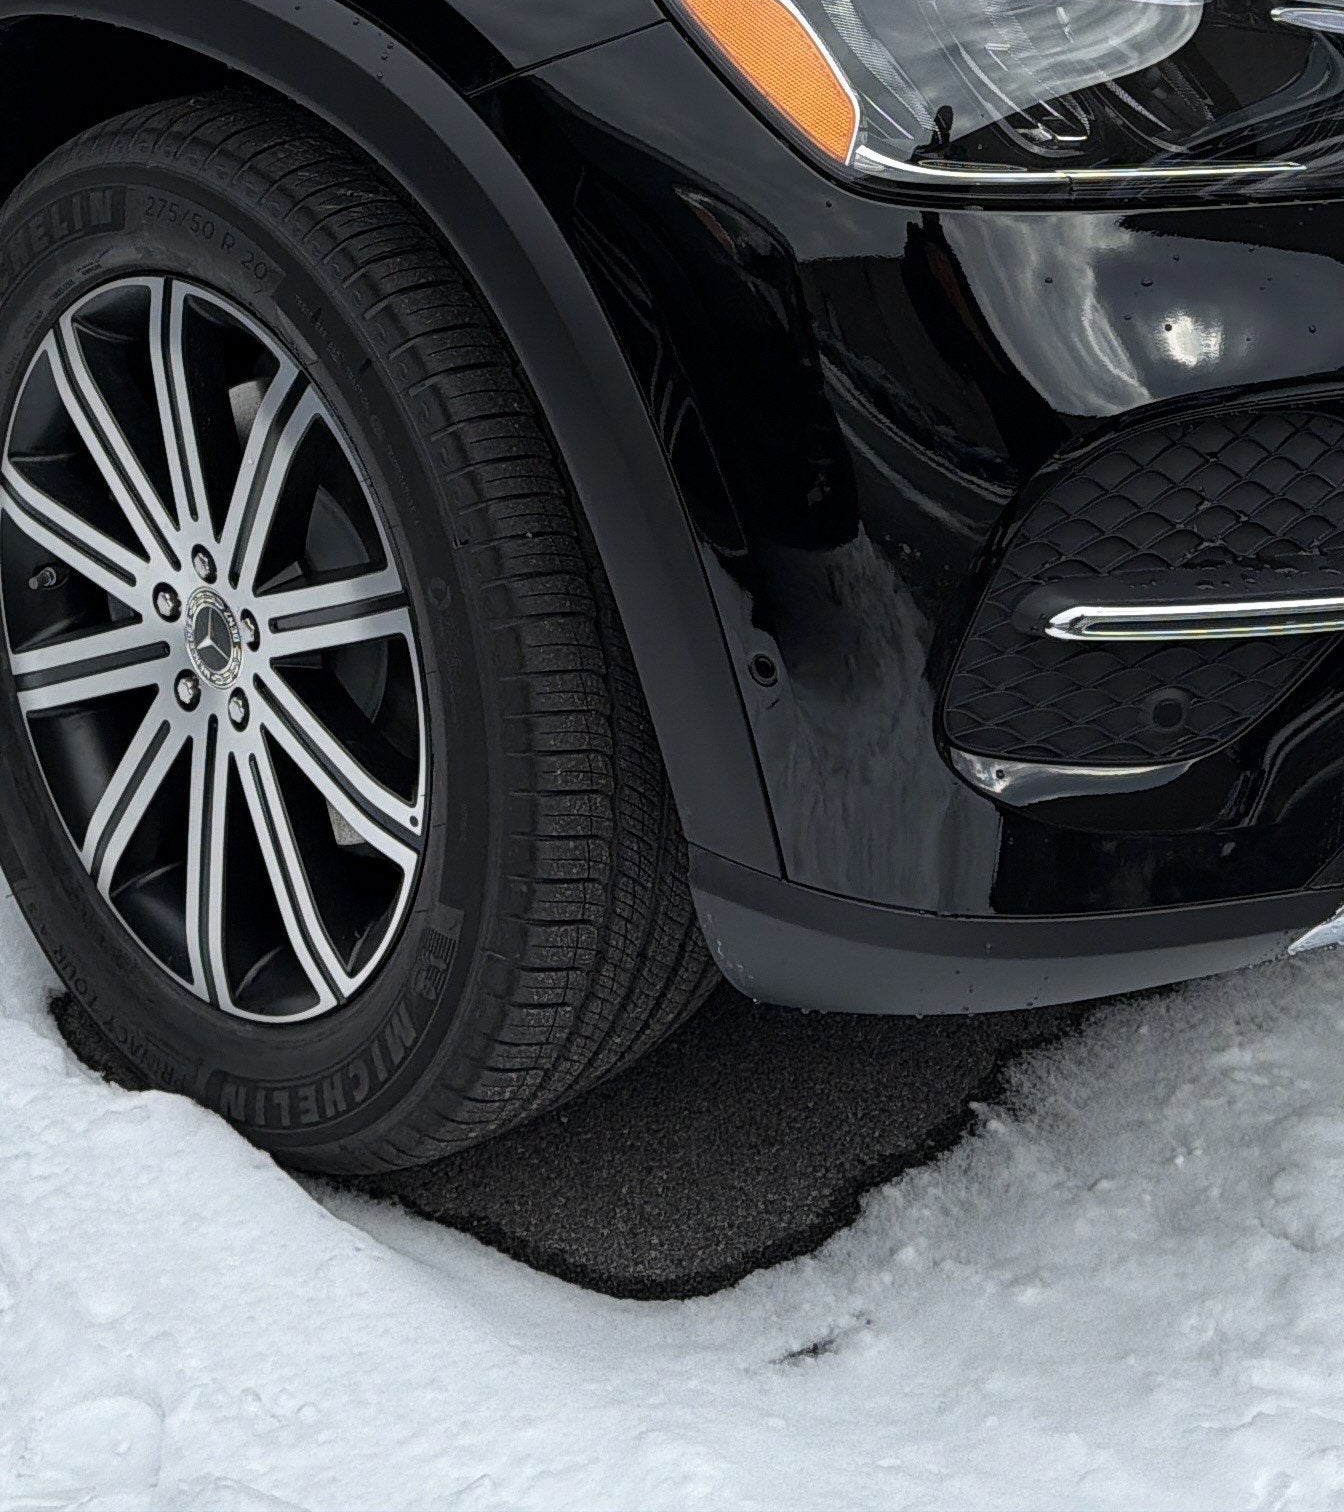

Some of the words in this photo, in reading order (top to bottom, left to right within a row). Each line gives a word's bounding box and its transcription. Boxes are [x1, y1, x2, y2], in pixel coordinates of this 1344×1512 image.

[144, 194, 215, 241] 275/50
[219, 233, 236, 253] R
[240, 249, 268, 282] 20
[52, 944, 102, 1010] TOUR
[219, 999, 417, 1128] MICHELIN
